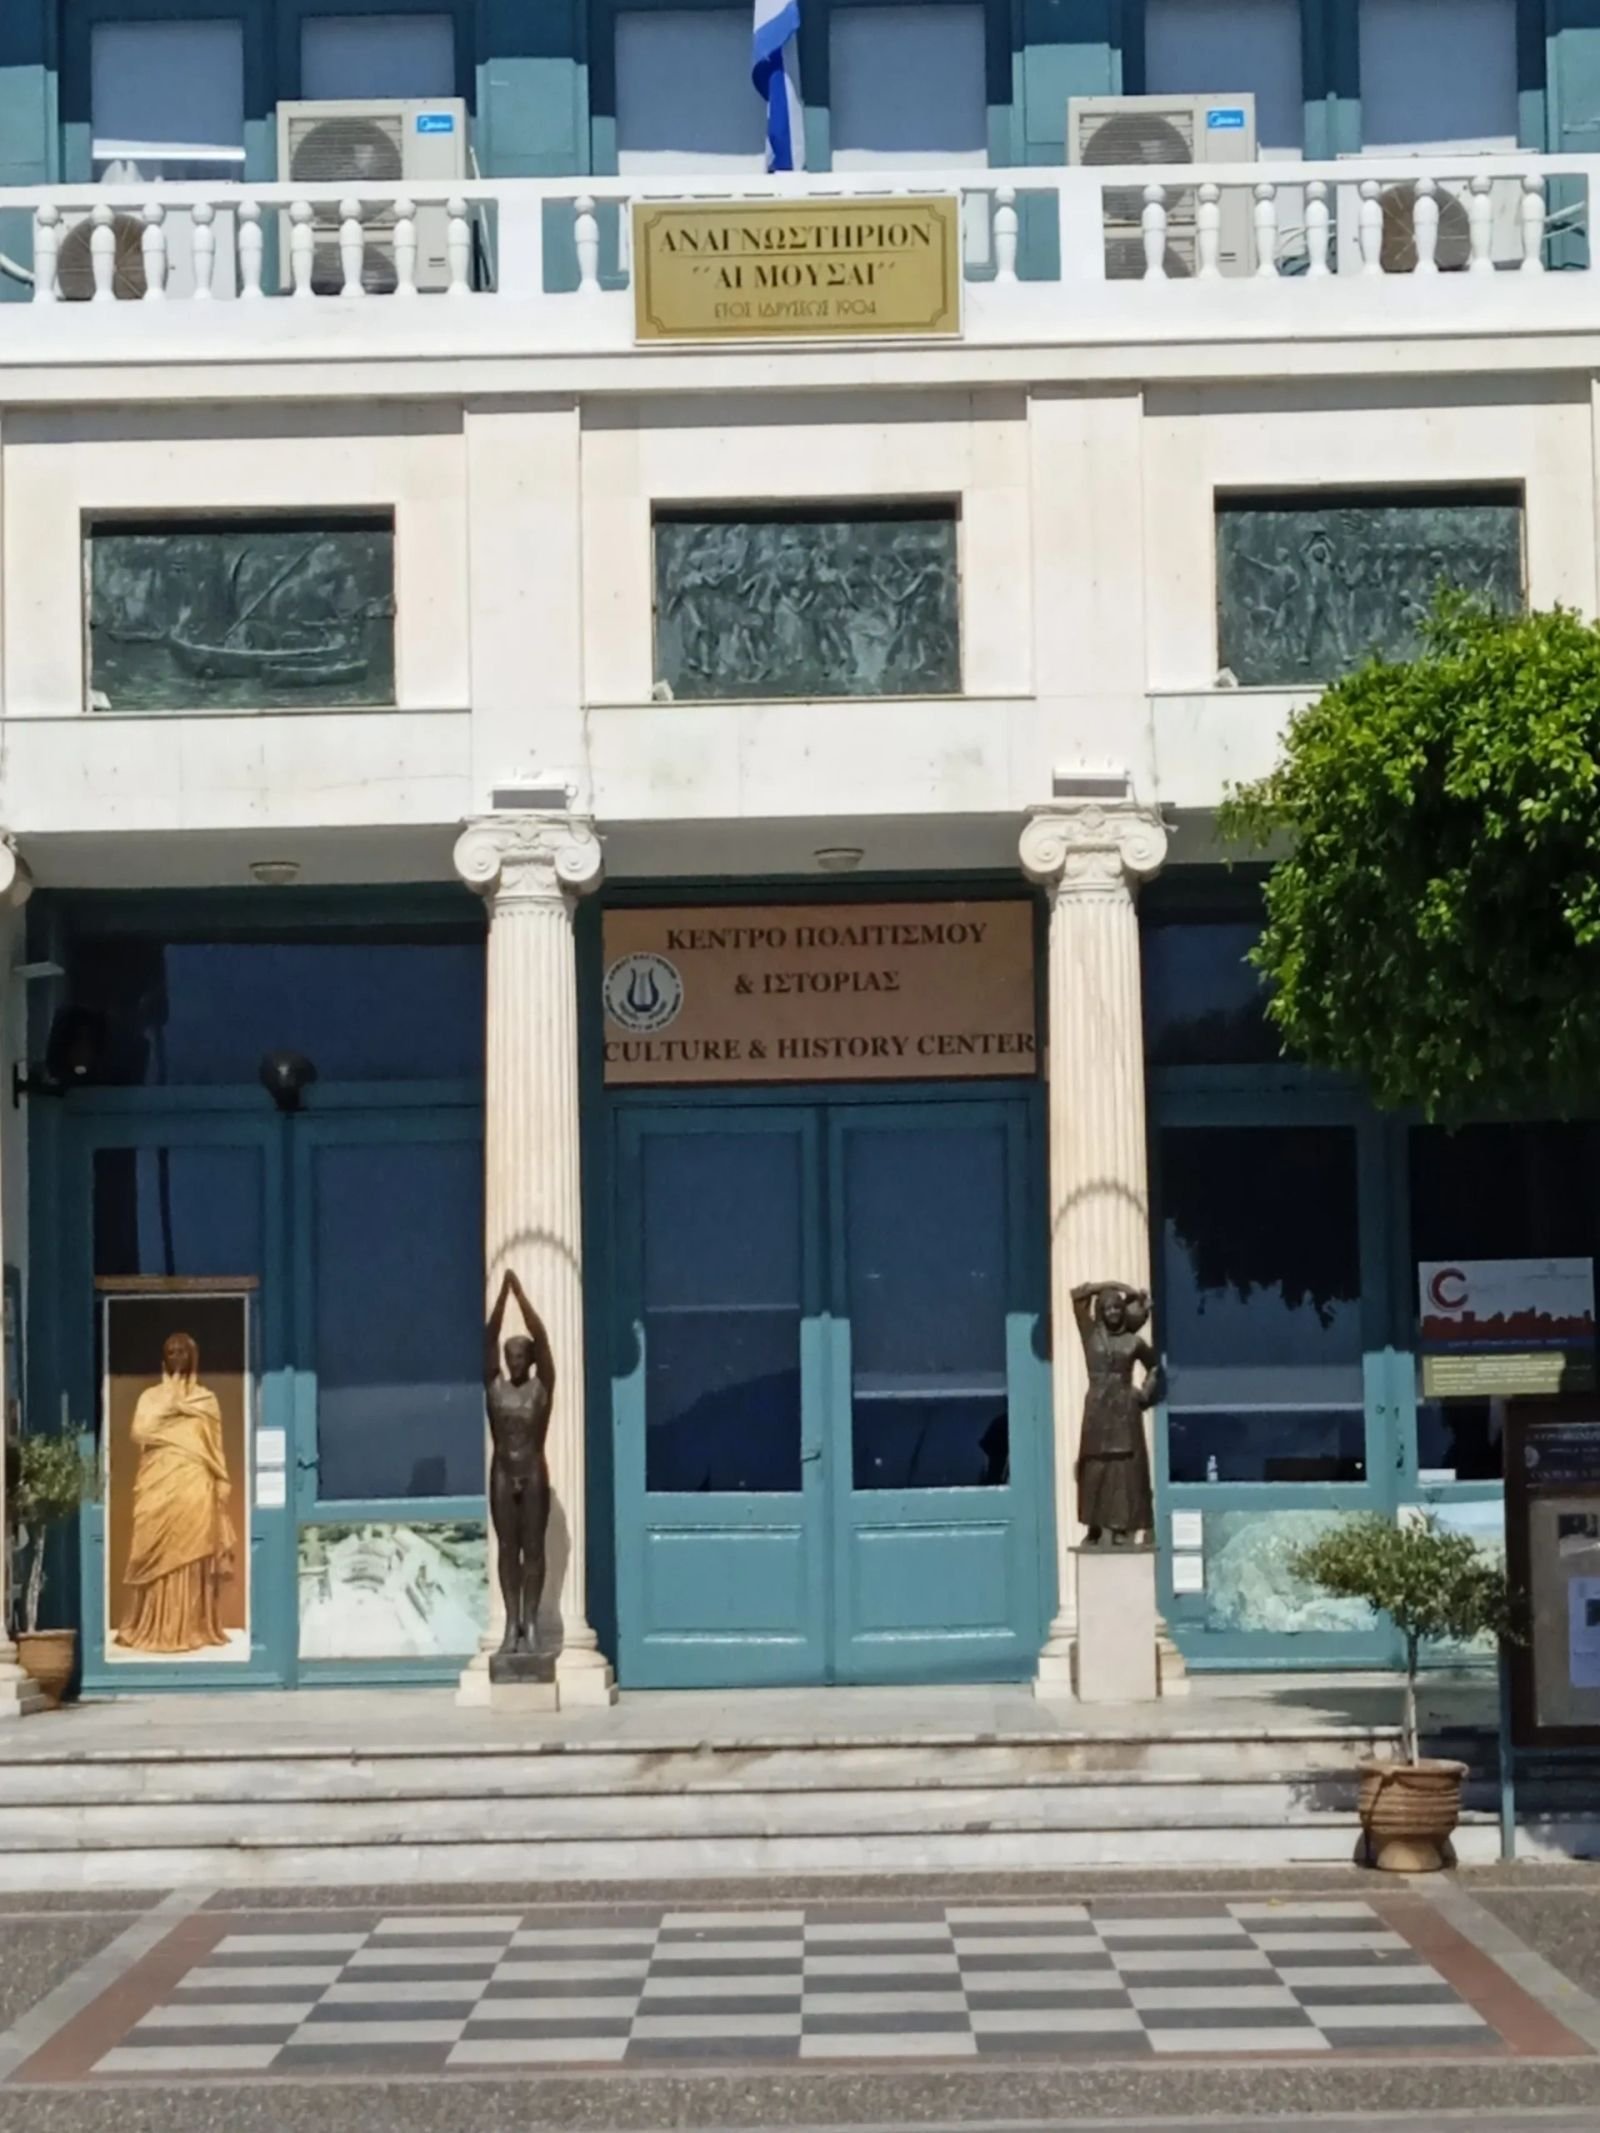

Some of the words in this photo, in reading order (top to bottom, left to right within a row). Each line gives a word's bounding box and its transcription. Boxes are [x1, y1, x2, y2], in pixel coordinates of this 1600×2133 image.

[660, 223, 932, 252] ΑΝΑΓΝΩΣΤΗΡΙΟΝ
[836, 299, 876, 315] 1904
[667, 928, 786, 950] ΚΕΝΤΡΟ
[796, 923, 987, 948] ΠΟΛΙΤΙΣΜΟΥ
[734, 974, 753, 995] &
[763, 970, 900, 993] ΙΣΤΟΡΙΑΣ
[603, 1039, 741, 1062] CULTURE
[748, 1037, 767, 1058] &
[777, 1035, 906, 1058] HISTORY
[917, 1033, 1036, 1055] CENTER
